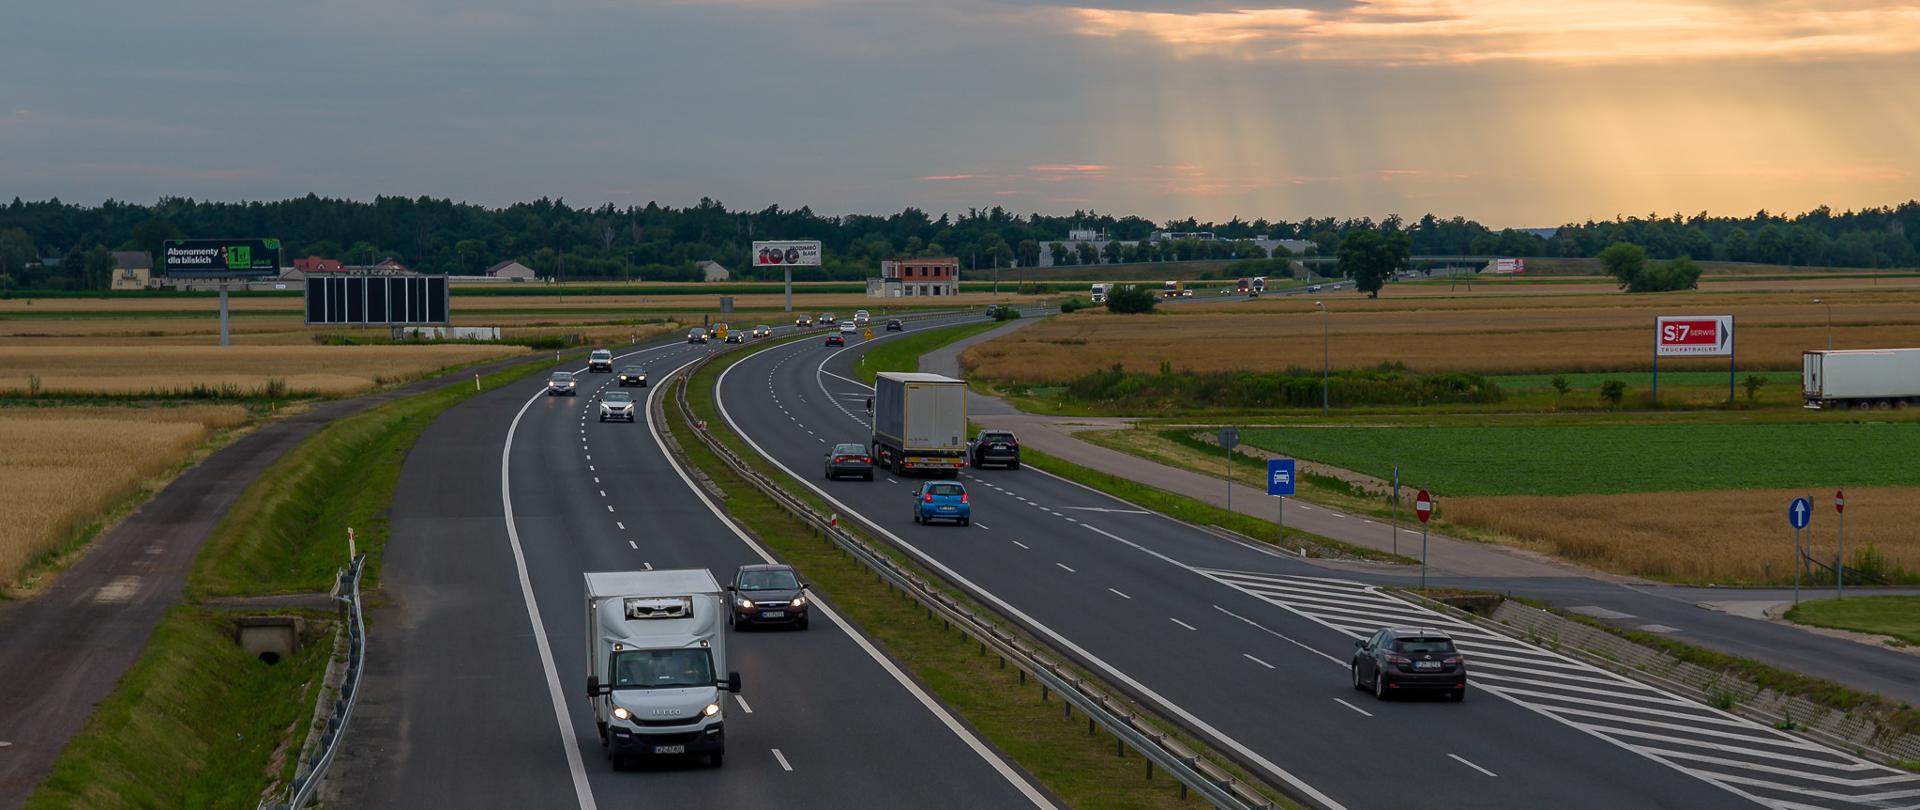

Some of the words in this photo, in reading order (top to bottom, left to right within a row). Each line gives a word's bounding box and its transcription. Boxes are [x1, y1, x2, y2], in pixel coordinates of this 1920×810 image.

[167, 247, 219, 256] Abonamenty
[231, 247, 239, 262] 1
[167, 256, 181, 264] dla
[182, 256, 212, 264] bliskich
[652, 708, 681, 716] IVECO
